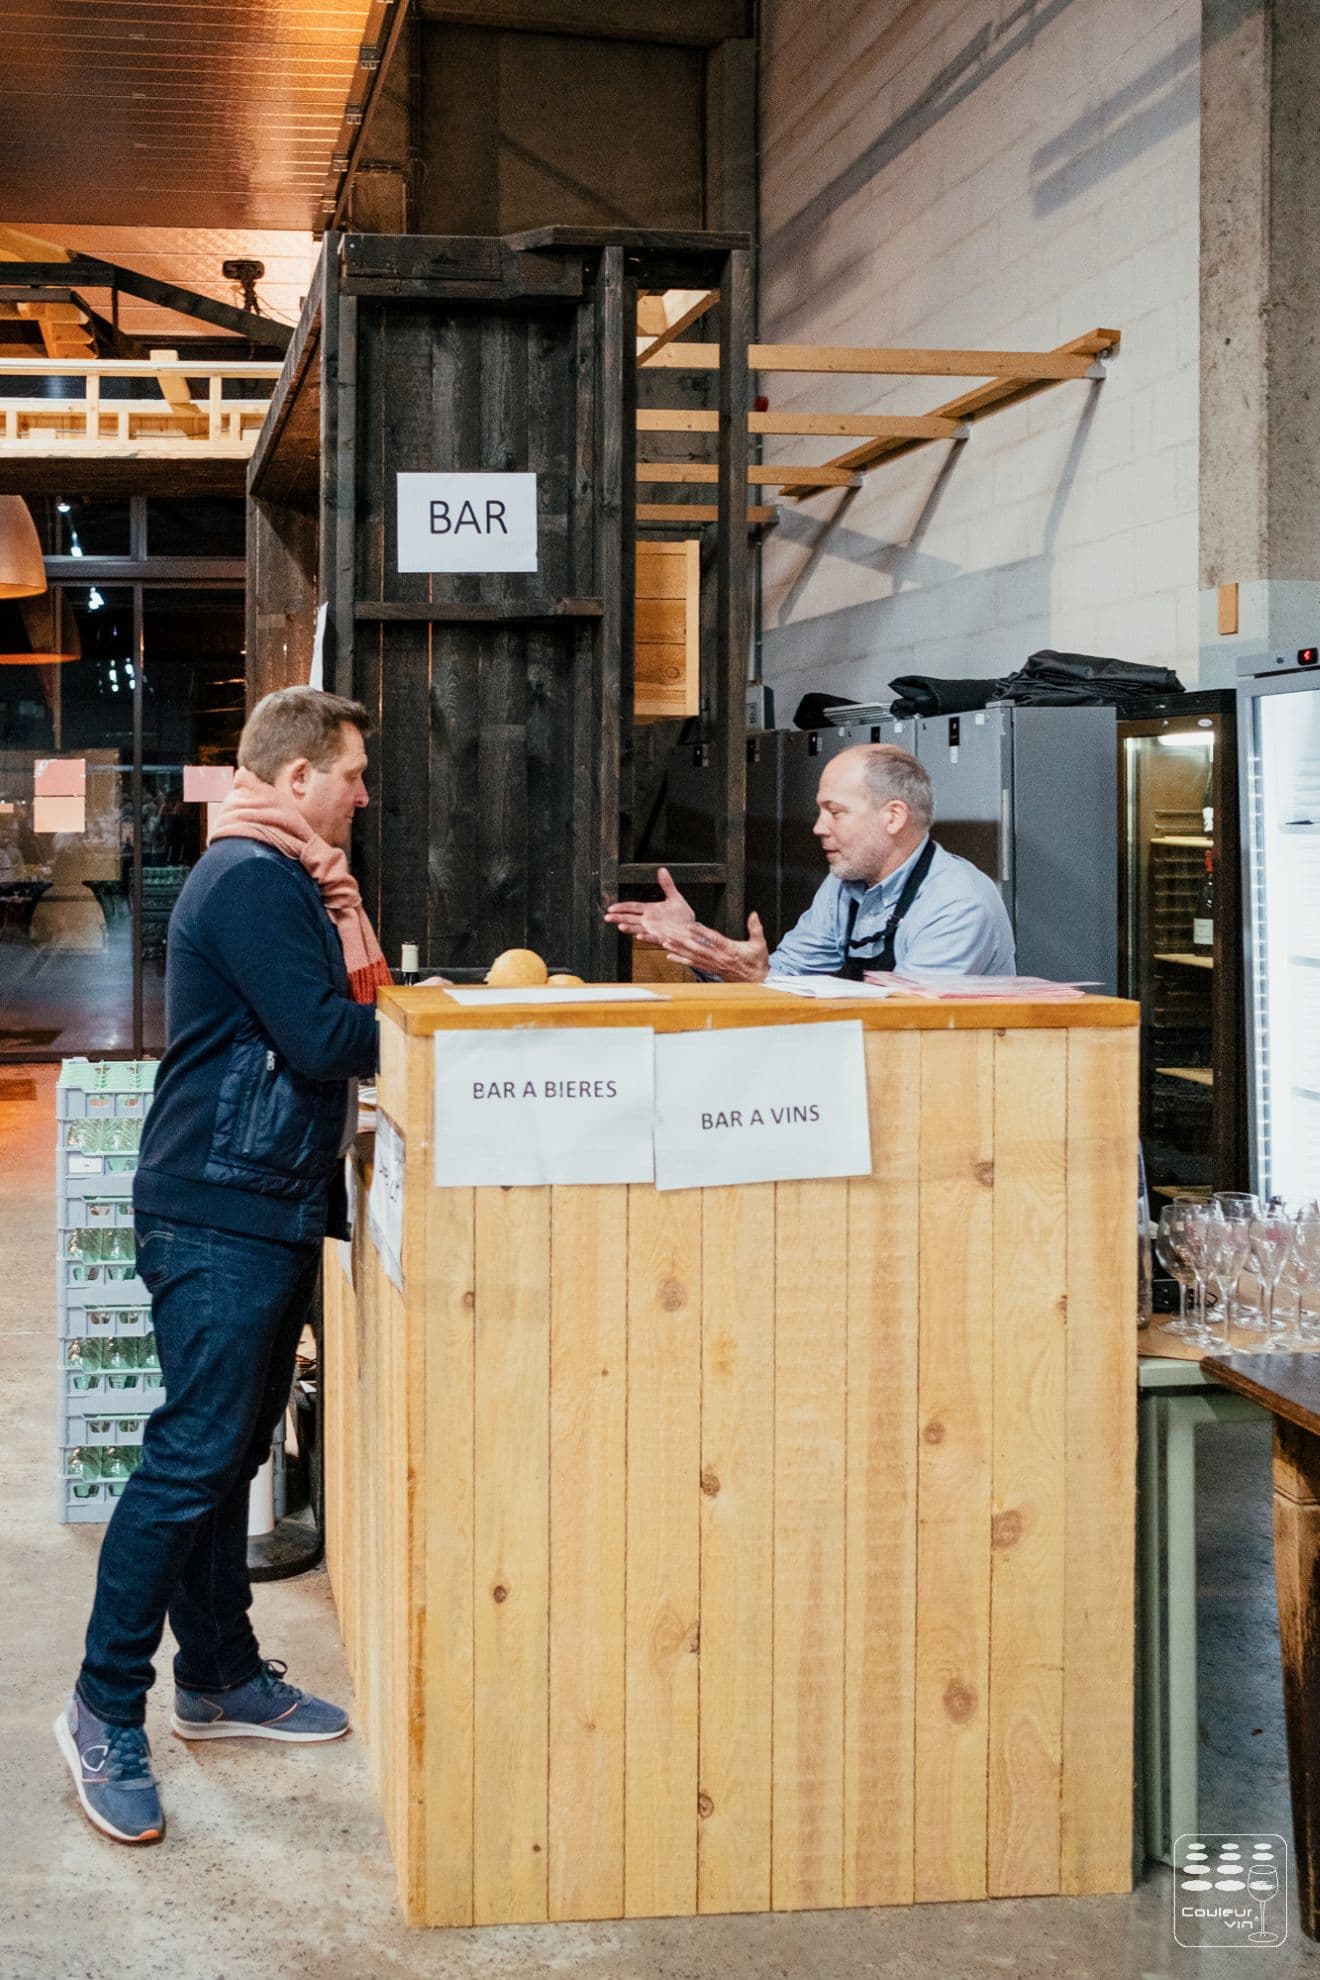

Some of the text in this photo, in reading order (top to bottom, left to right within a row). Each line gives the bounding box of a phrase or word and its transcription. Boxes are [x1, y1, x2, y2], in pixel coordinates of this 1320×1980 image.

[430, 500, 508, 534] BAR
[473, 1080, 617, 1099] BAR A BIERES
[701, 1104, 820, 1130] BAR A VINS
